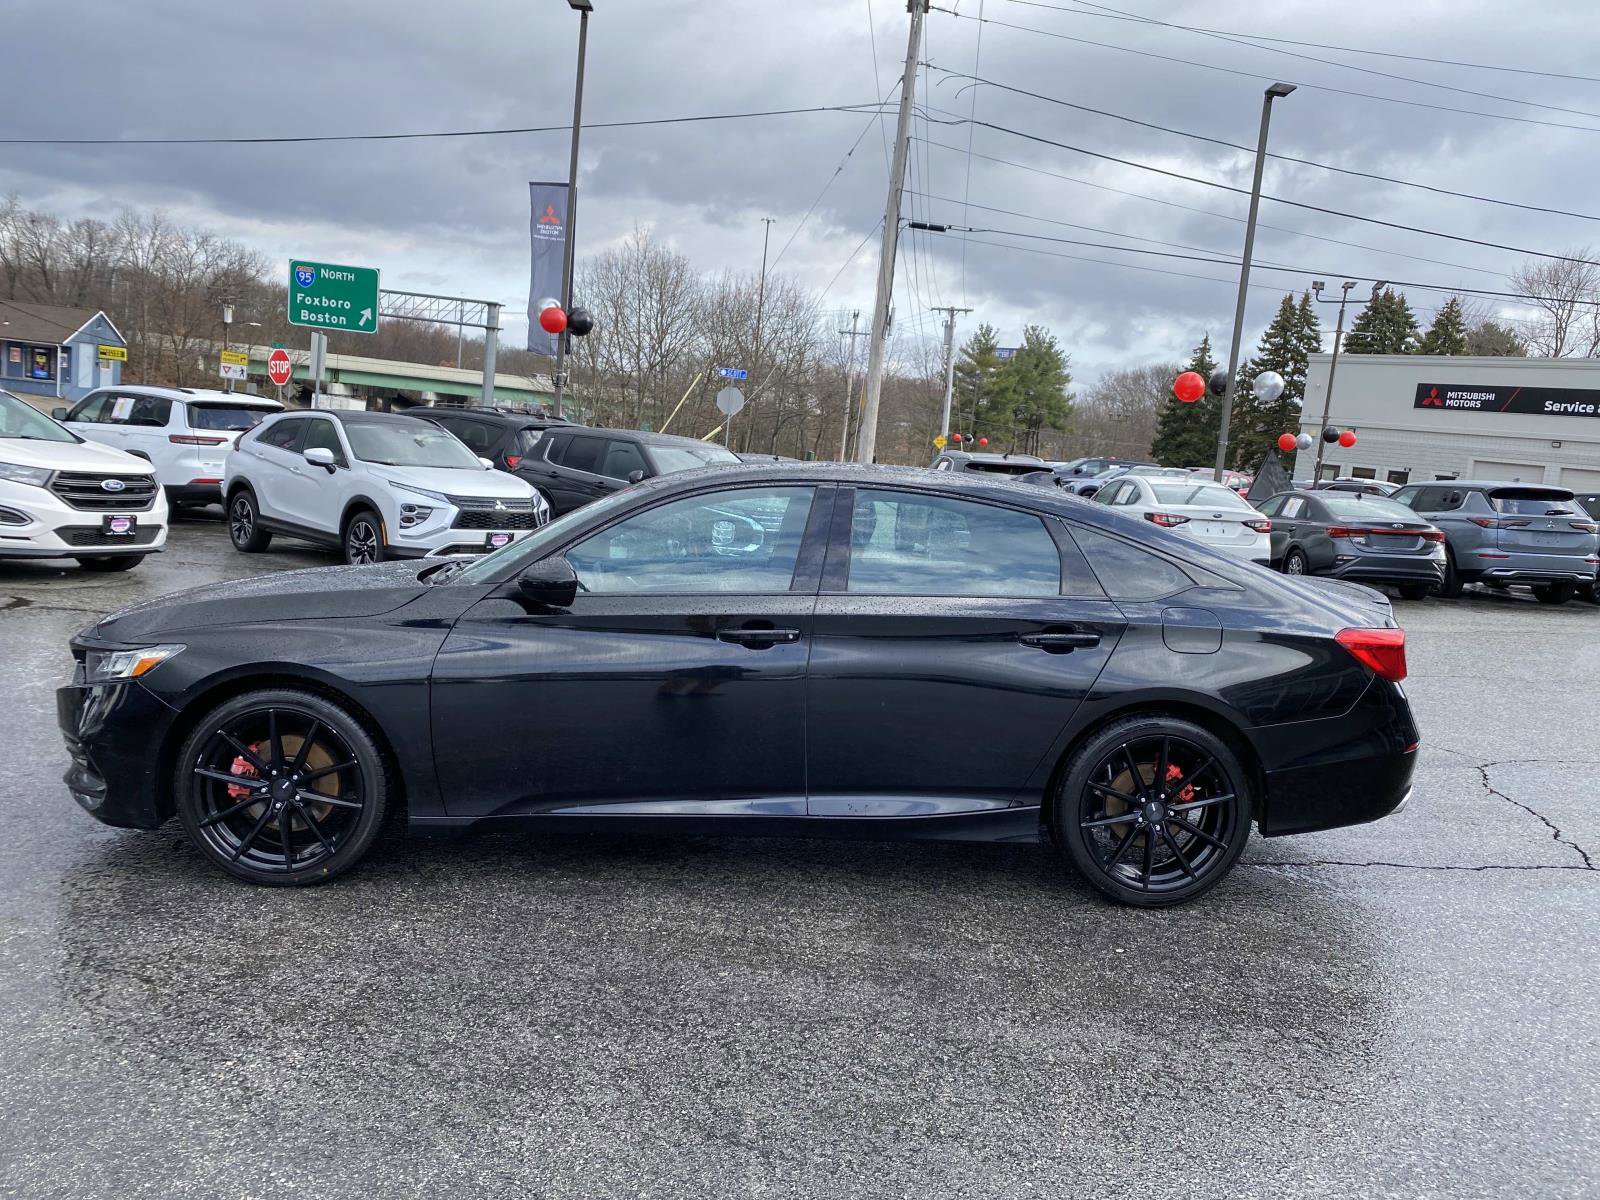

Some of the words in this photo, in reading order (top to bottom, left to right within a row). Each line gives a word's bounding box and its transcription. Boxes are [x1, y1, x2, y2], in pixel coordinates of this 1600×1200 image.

[299, 272, 312, 283] 95
[320, 268, 355, 281] NORTH
[296, 293, 351, 309] Foxboro
[301, 310, 347, 325] Boston
[270, 360, 289, 374] STOP
[1446, 391, 1496, 400] MITSUBISHI
[1445, 399, 1482, 408] MOTORS
[1544, 400, 1595, 413] Service
